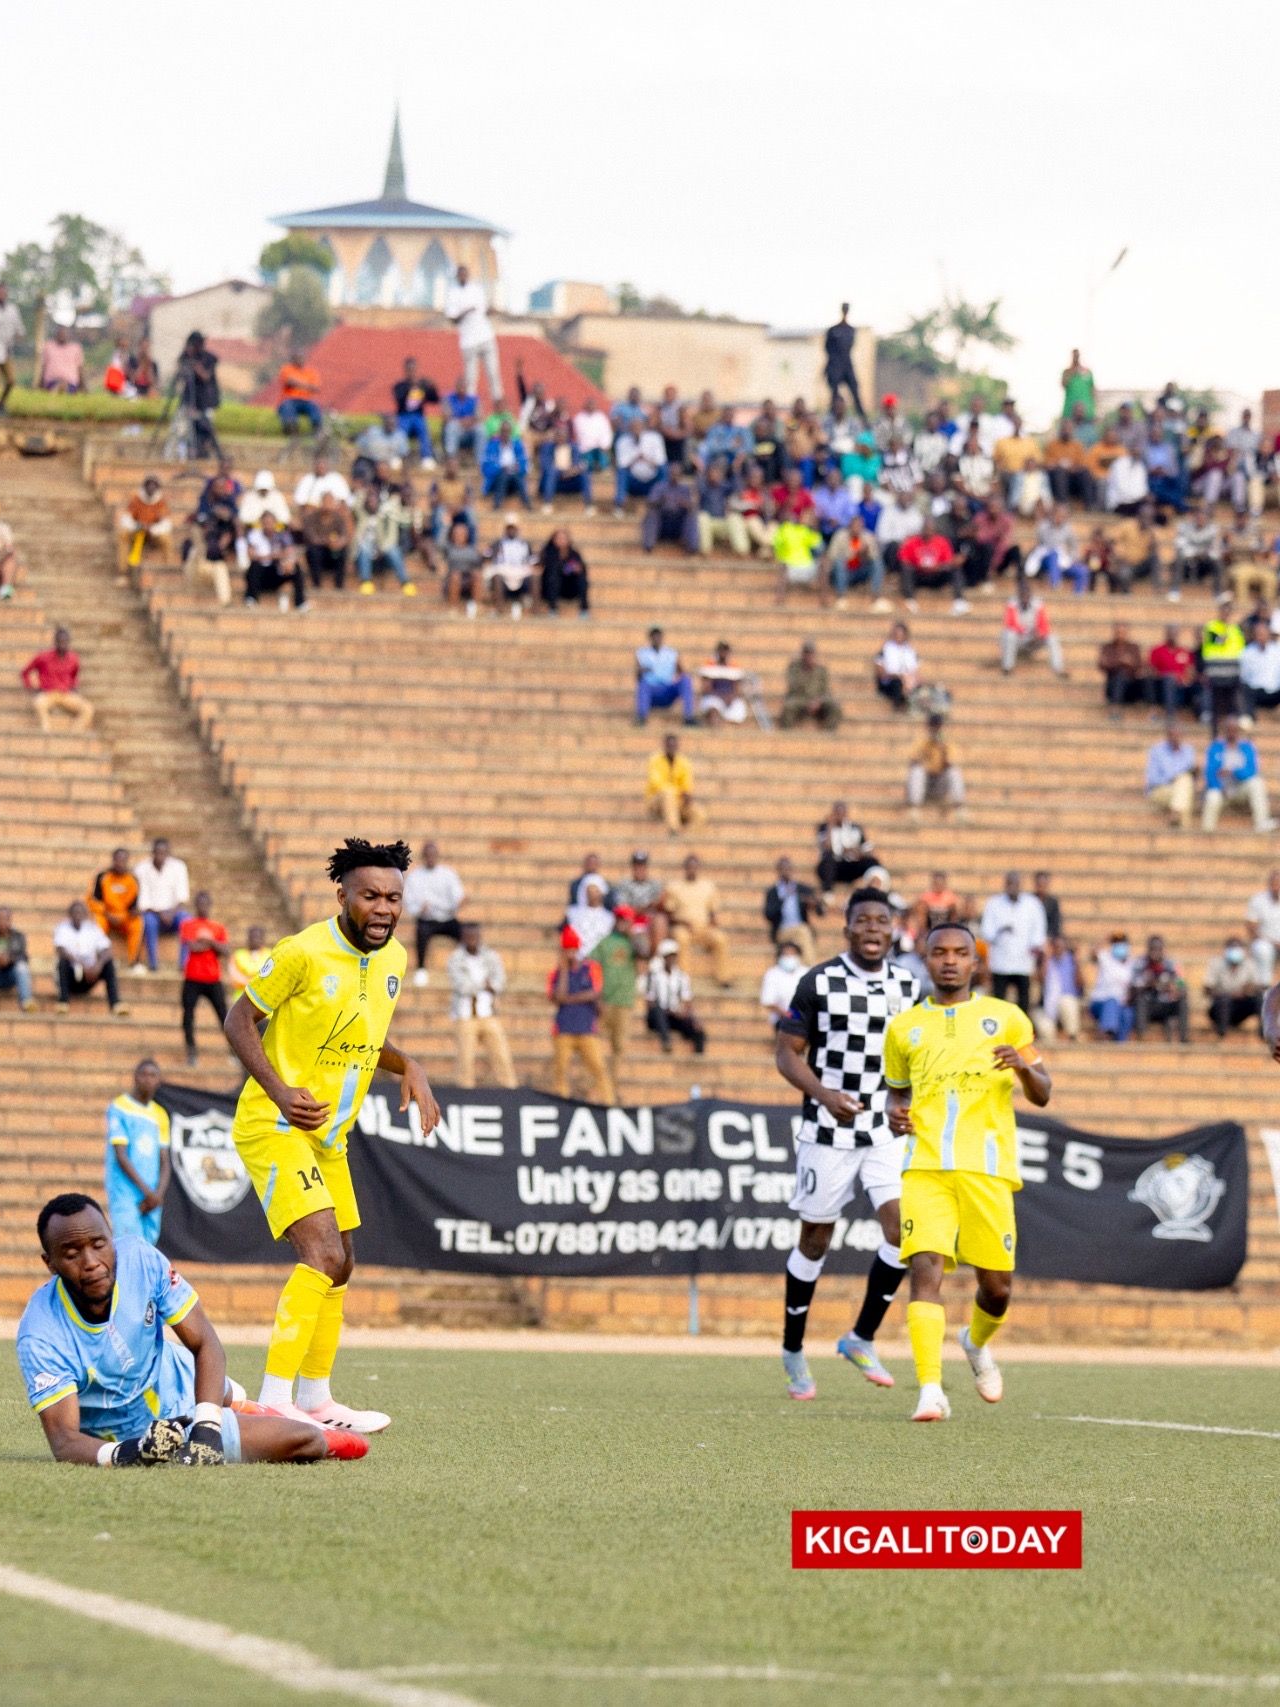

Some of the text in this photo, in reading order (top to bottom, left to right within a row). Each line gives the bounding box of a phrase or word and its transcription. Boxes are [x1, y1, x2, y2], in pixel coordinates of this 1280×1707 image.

[349, 1094, 1104, 1191] NLINE FANS CL E 5
[297, 1166, 324, 1191] 14
[517, 1164, 798, 1214] Unity as one Fam
[902, 1218, 914, 1240] 9
